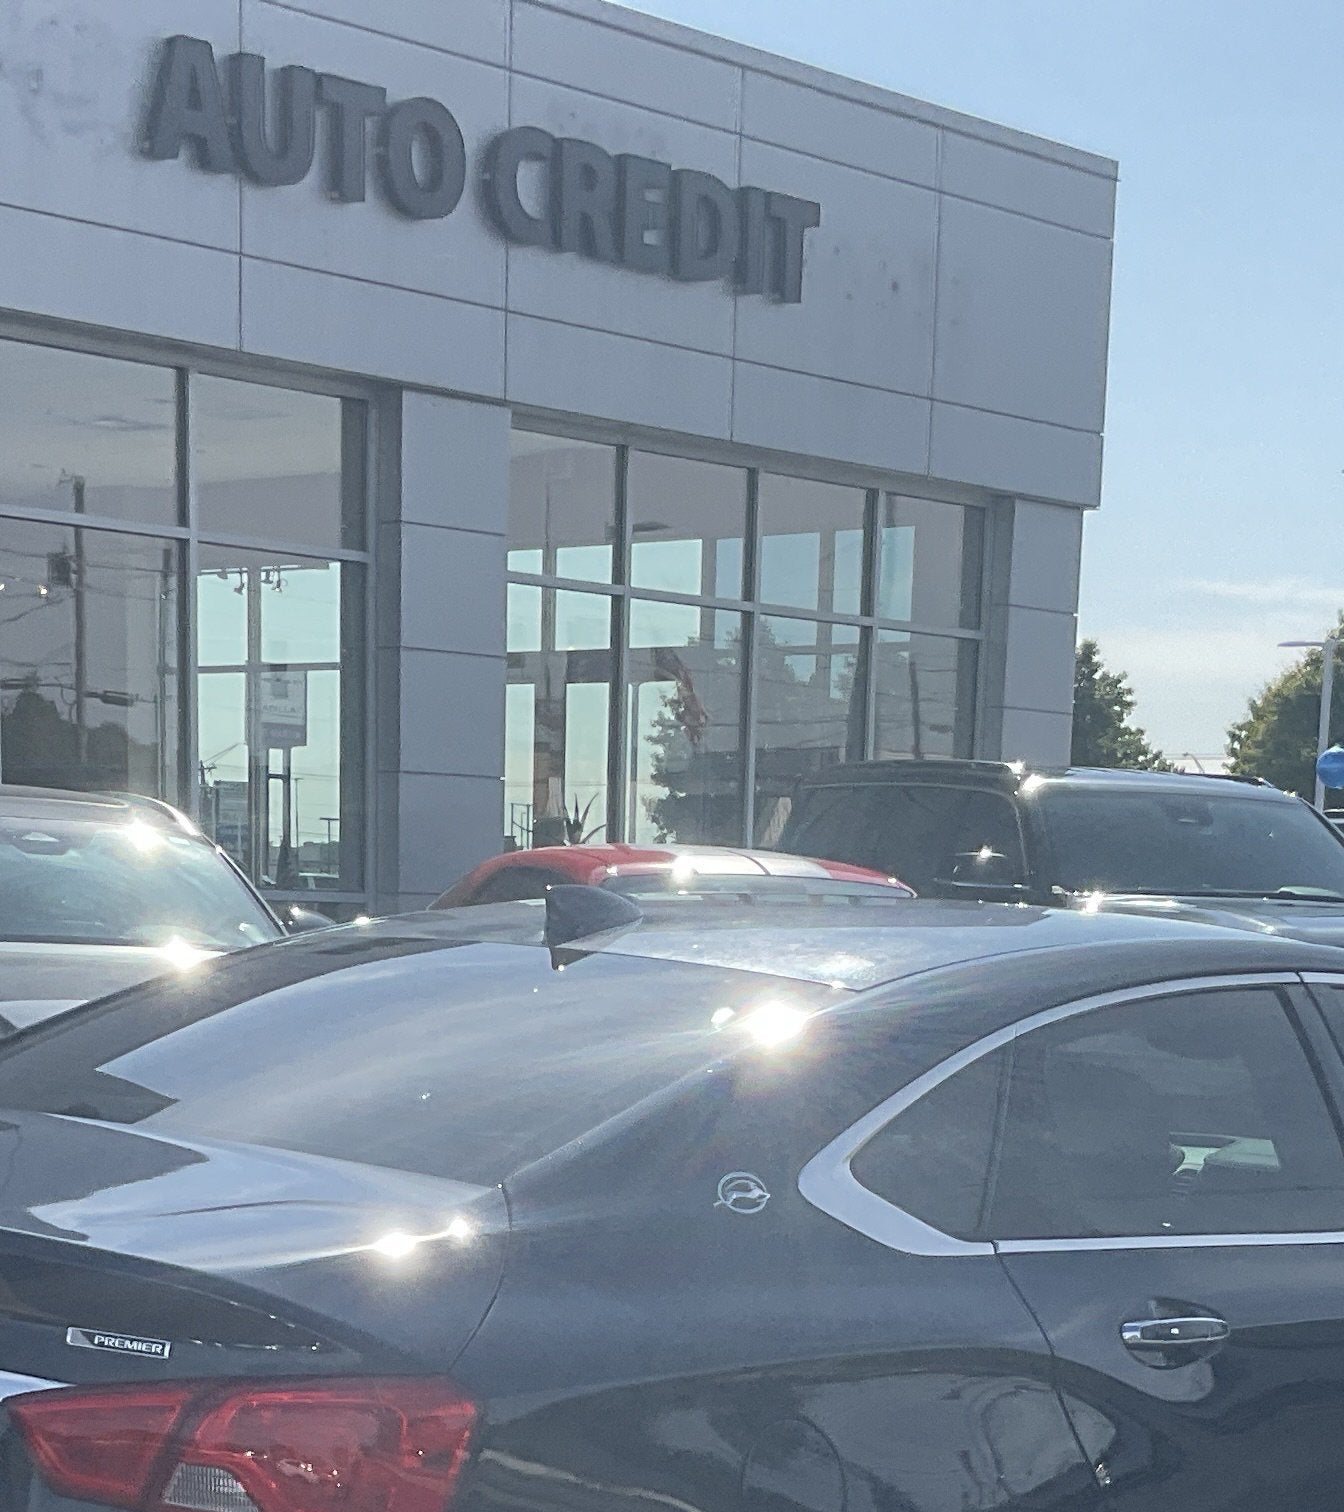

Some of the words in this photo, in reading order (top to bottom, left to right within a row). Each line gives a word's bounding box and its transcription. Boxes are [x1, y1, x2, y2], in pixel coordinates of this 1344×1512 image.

[141, 34, 466, 220] AUTO
[480, 126, 821, 305] CREDIT
[94, 1334, 163, 1354] PREMIER
